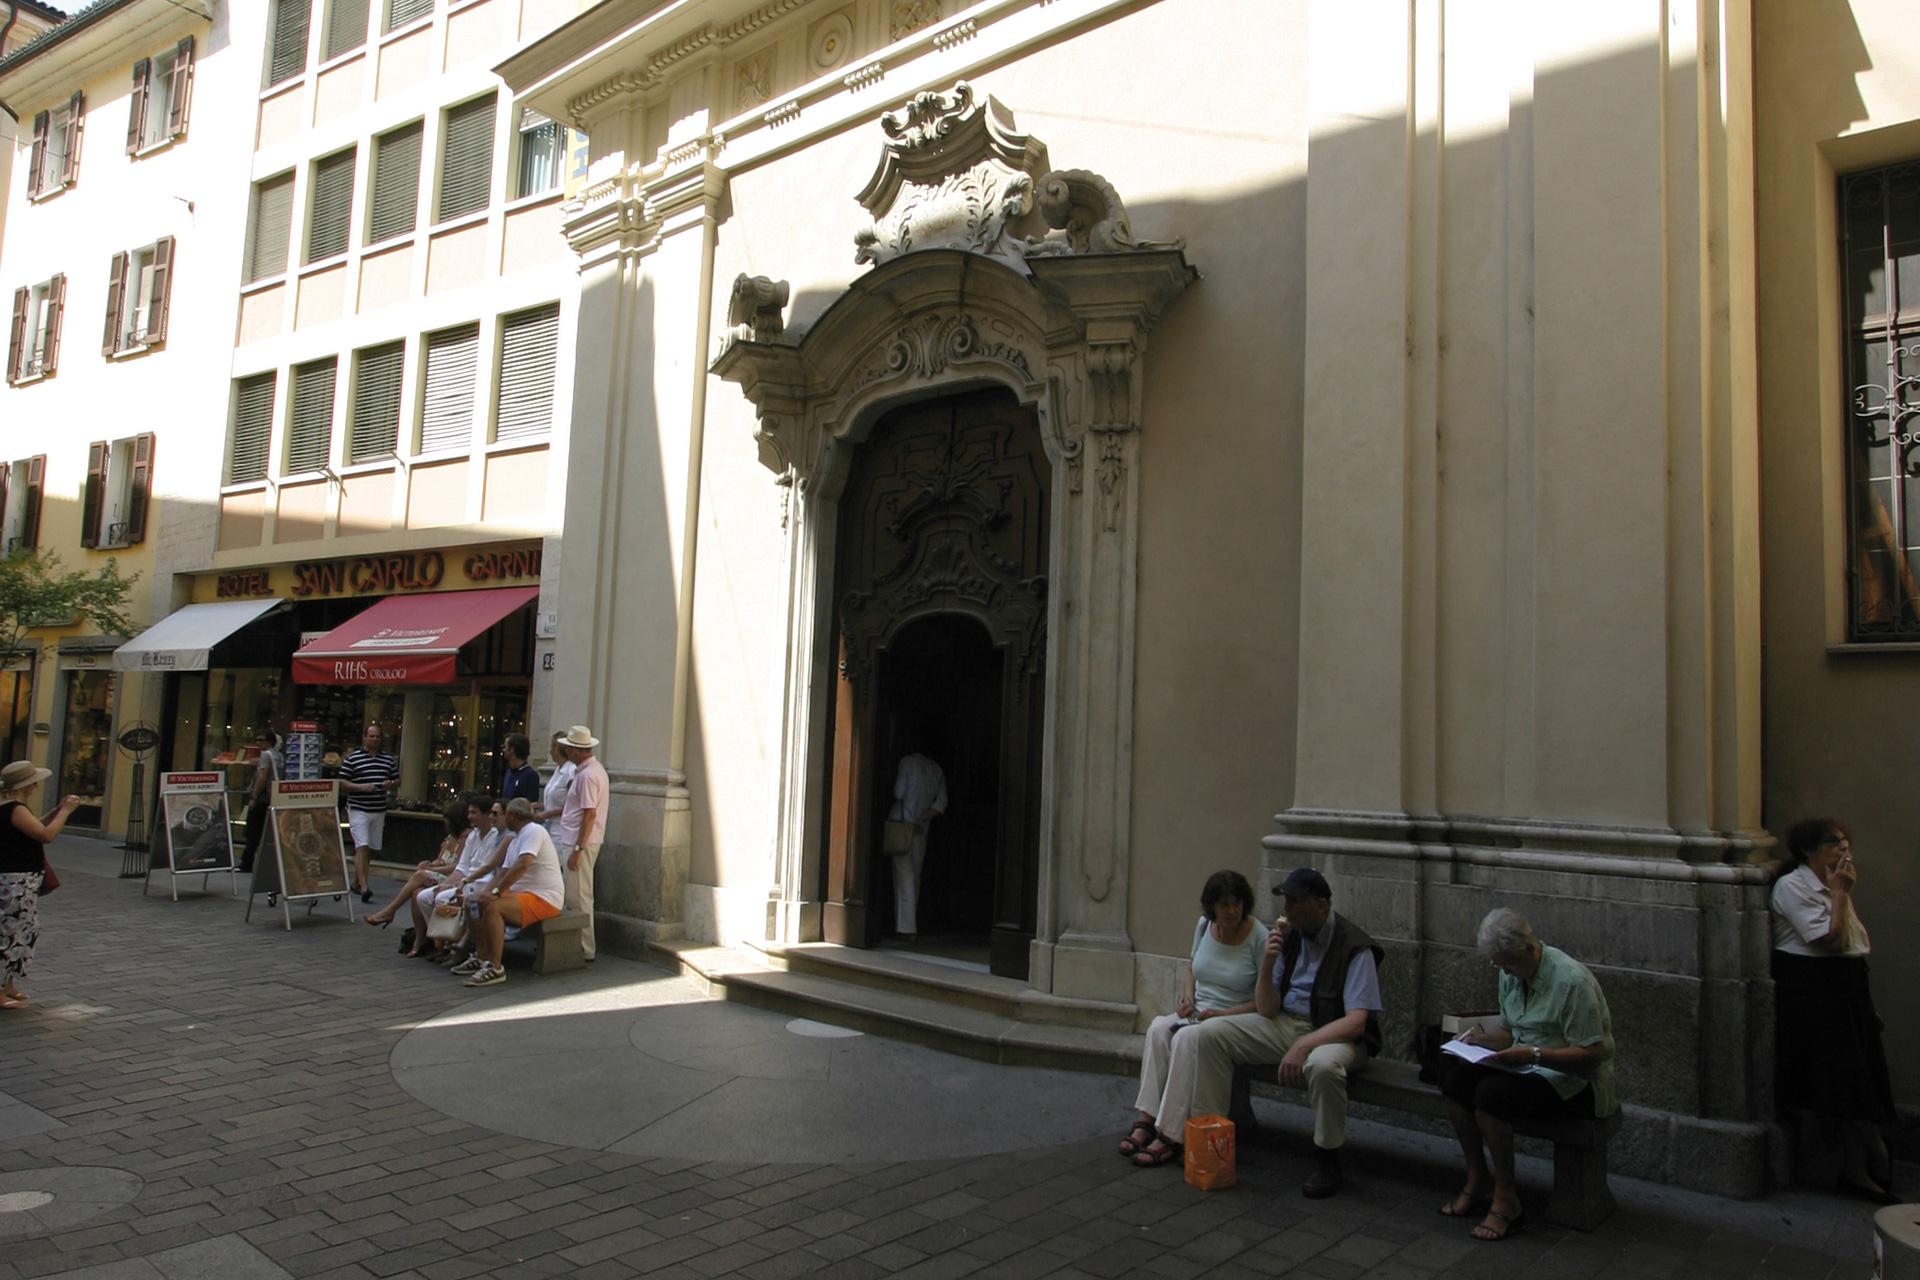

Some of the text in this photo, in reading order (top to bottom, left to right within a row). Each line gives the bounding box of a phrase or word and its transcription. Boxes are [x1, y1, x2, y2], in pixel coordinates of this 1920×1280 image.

[217, 550, 540, 597] HOTEL SAN CARLO GARNI
[334, 661, 407, 680] RIHS OROLOGI
